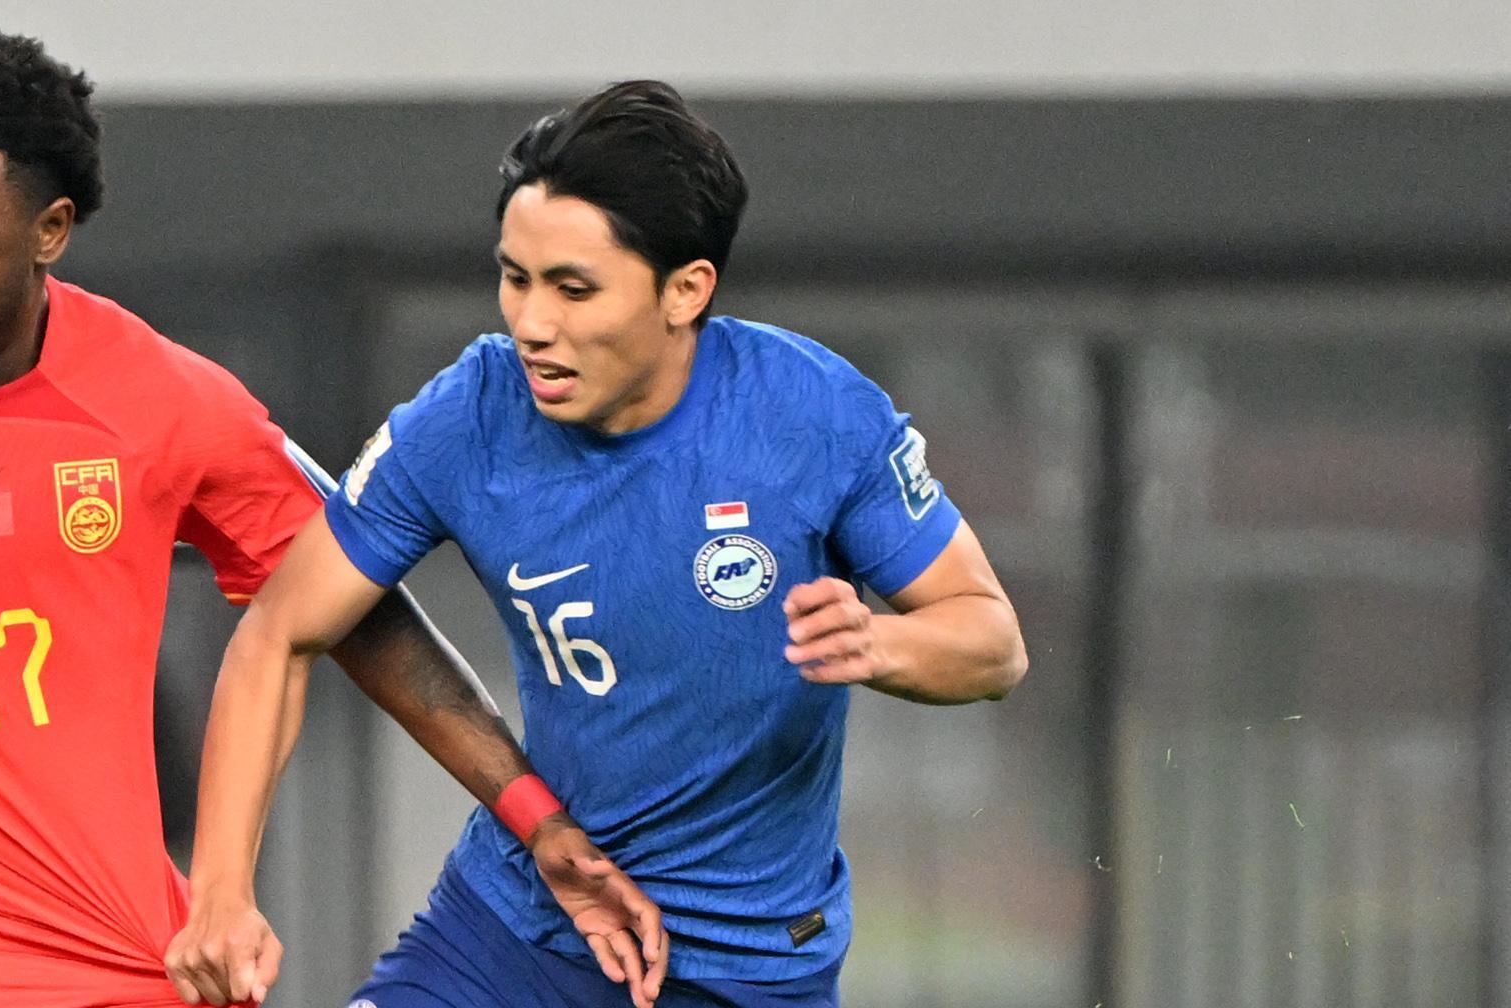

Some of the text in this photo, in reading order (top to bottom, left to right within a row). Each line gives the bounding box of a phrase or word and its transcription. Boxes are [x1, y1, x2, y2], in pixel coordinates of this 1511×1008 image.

[61, 465, 114, 486] CFA
[724, 537, 773, 576] ASSOCIATION
[710, 587, 767, 607] SINGAPORE
[510, 598, 618, 696] 16
